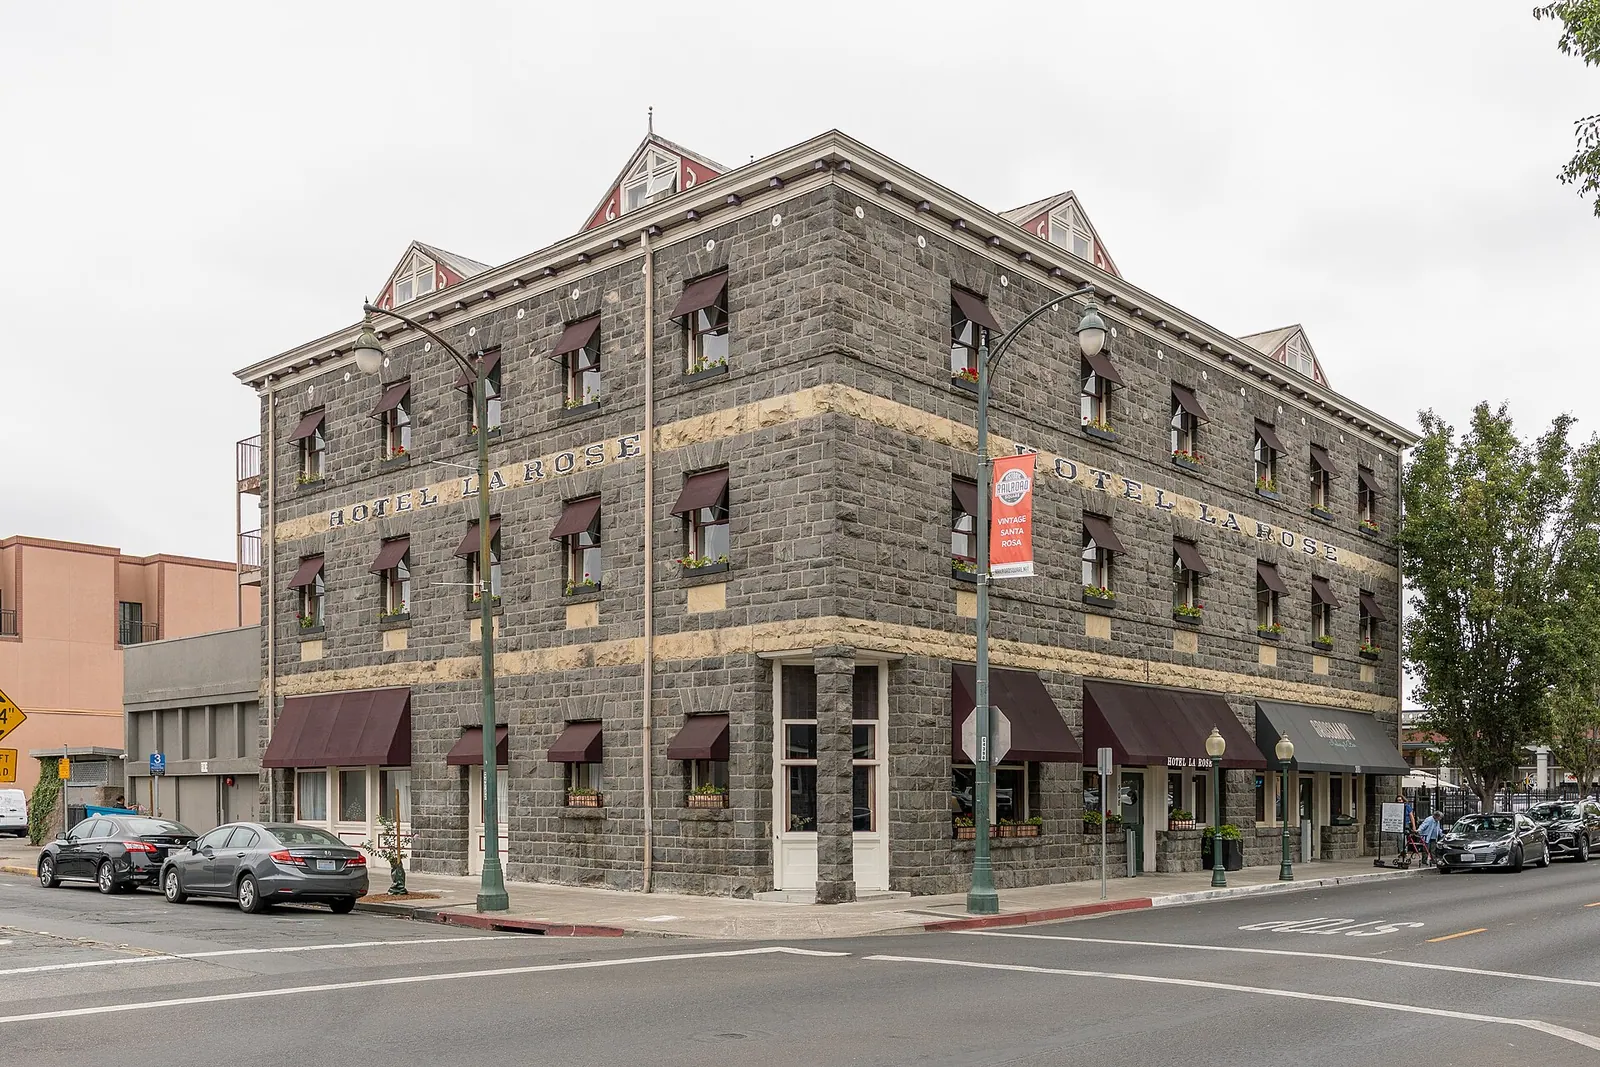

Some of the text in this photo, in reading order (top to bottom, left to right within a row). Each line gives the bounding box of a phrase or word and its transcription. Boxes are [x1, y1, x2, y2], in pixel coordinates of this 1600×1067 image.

[328, 433, 642, 527] HOTEL LA ROSE
[997, 480, 1029, 494] RAILROAD
[997, 515, 1027, 525] VINTAGE
[1000, 527, 1025, 537] SANTA
[1198, 503, 1242, 533] LA
[1255, 522, 1339, 563] ROSE
[1001, 540, 1022, 548] ROSA
[154, 753, 162, 764] 3
[1167, 756, 1213, 768] HOTEL LA ROSE
